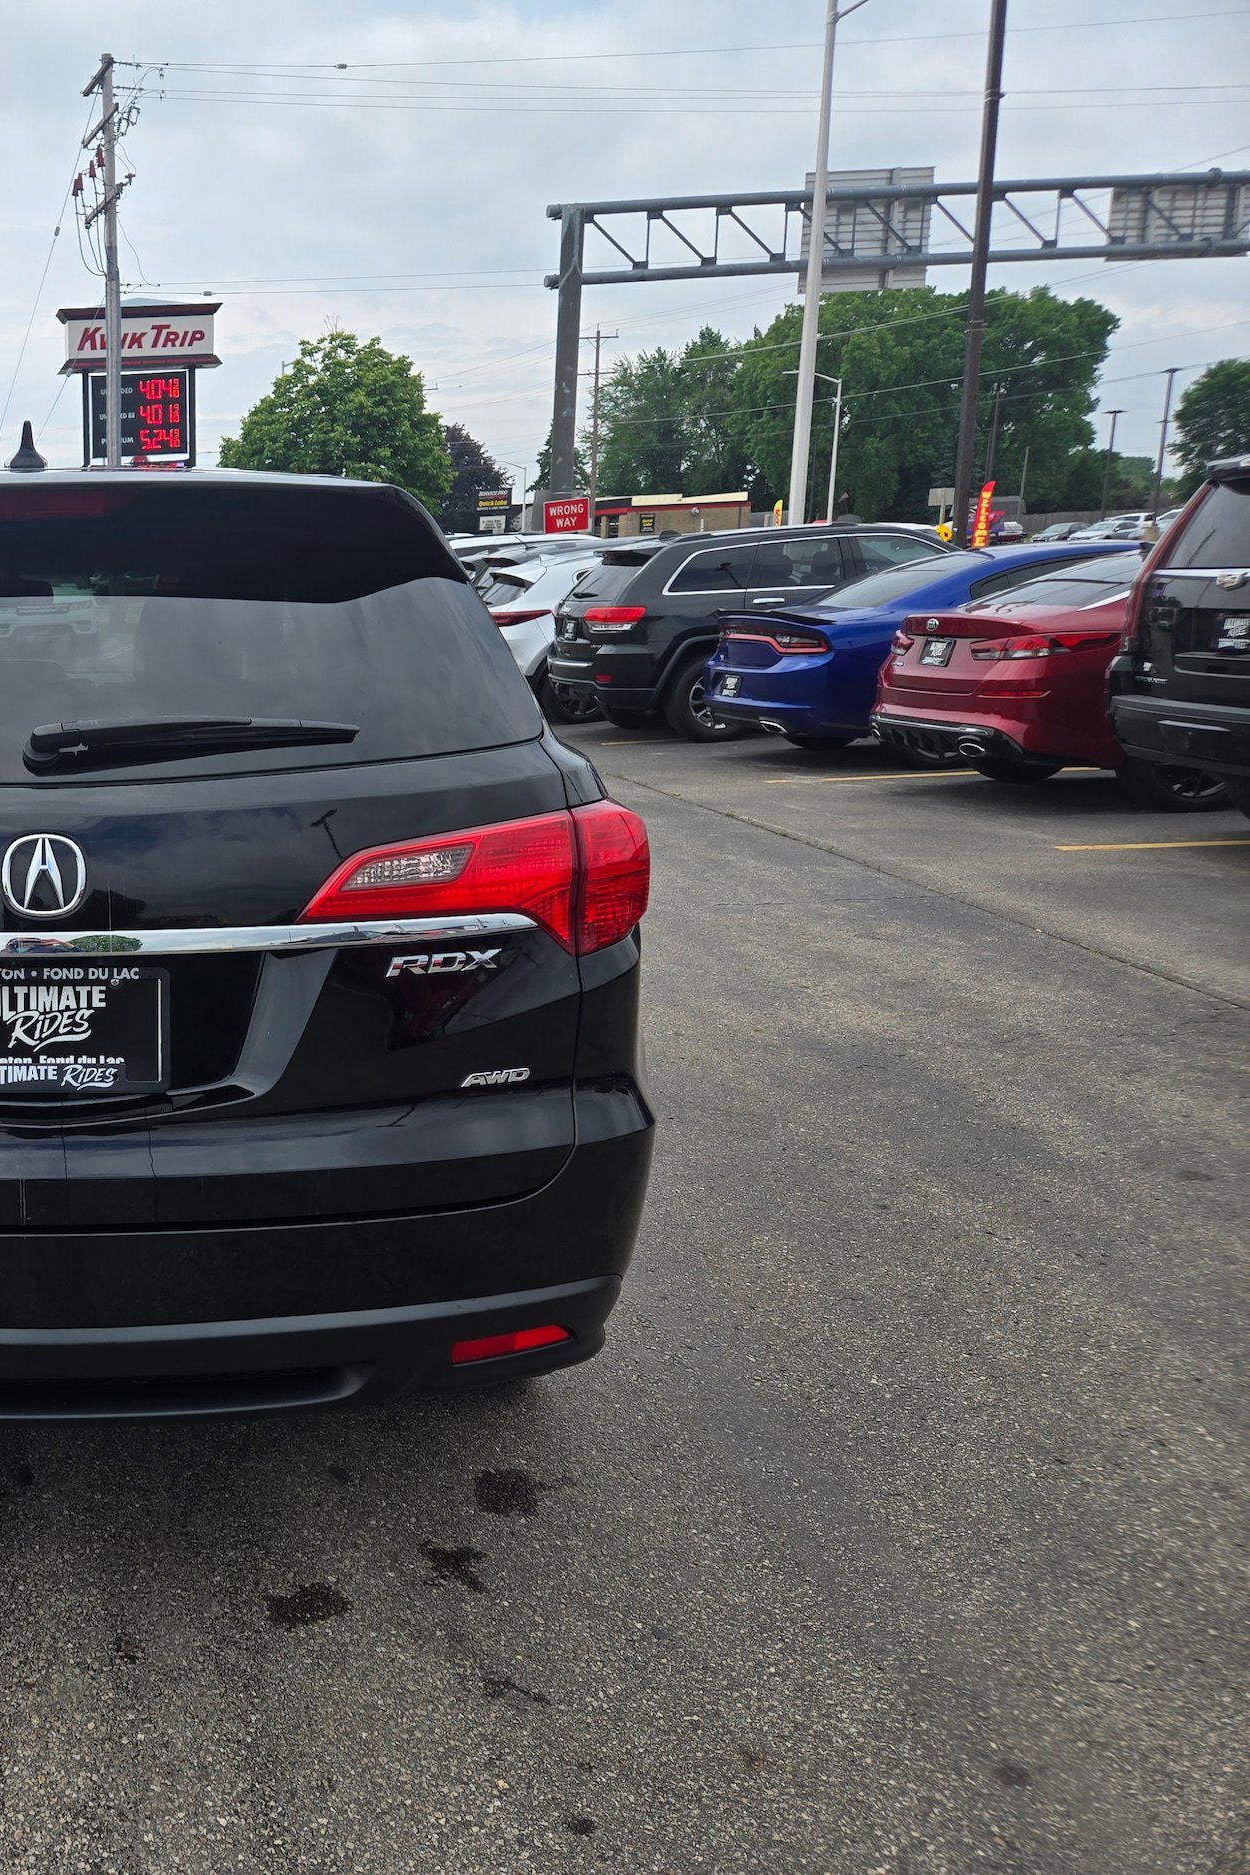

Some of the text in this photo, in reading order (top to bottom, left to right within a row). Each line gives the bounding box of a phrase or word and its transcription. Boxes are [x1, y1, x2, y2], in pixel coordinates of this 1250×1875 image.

[77, 324, 206, 351] KIK TRIP
[549, 503, 584, 517] WRONG
[556, 516, 577, 528] WAY
[386, 948, 502, 978] RDX
[43, 968, 83, 980] FOND
[88, 968, 109, 979] DU
[113, 968, 140, 980] LAC
[460, 1067, 531, 1088] AWD
